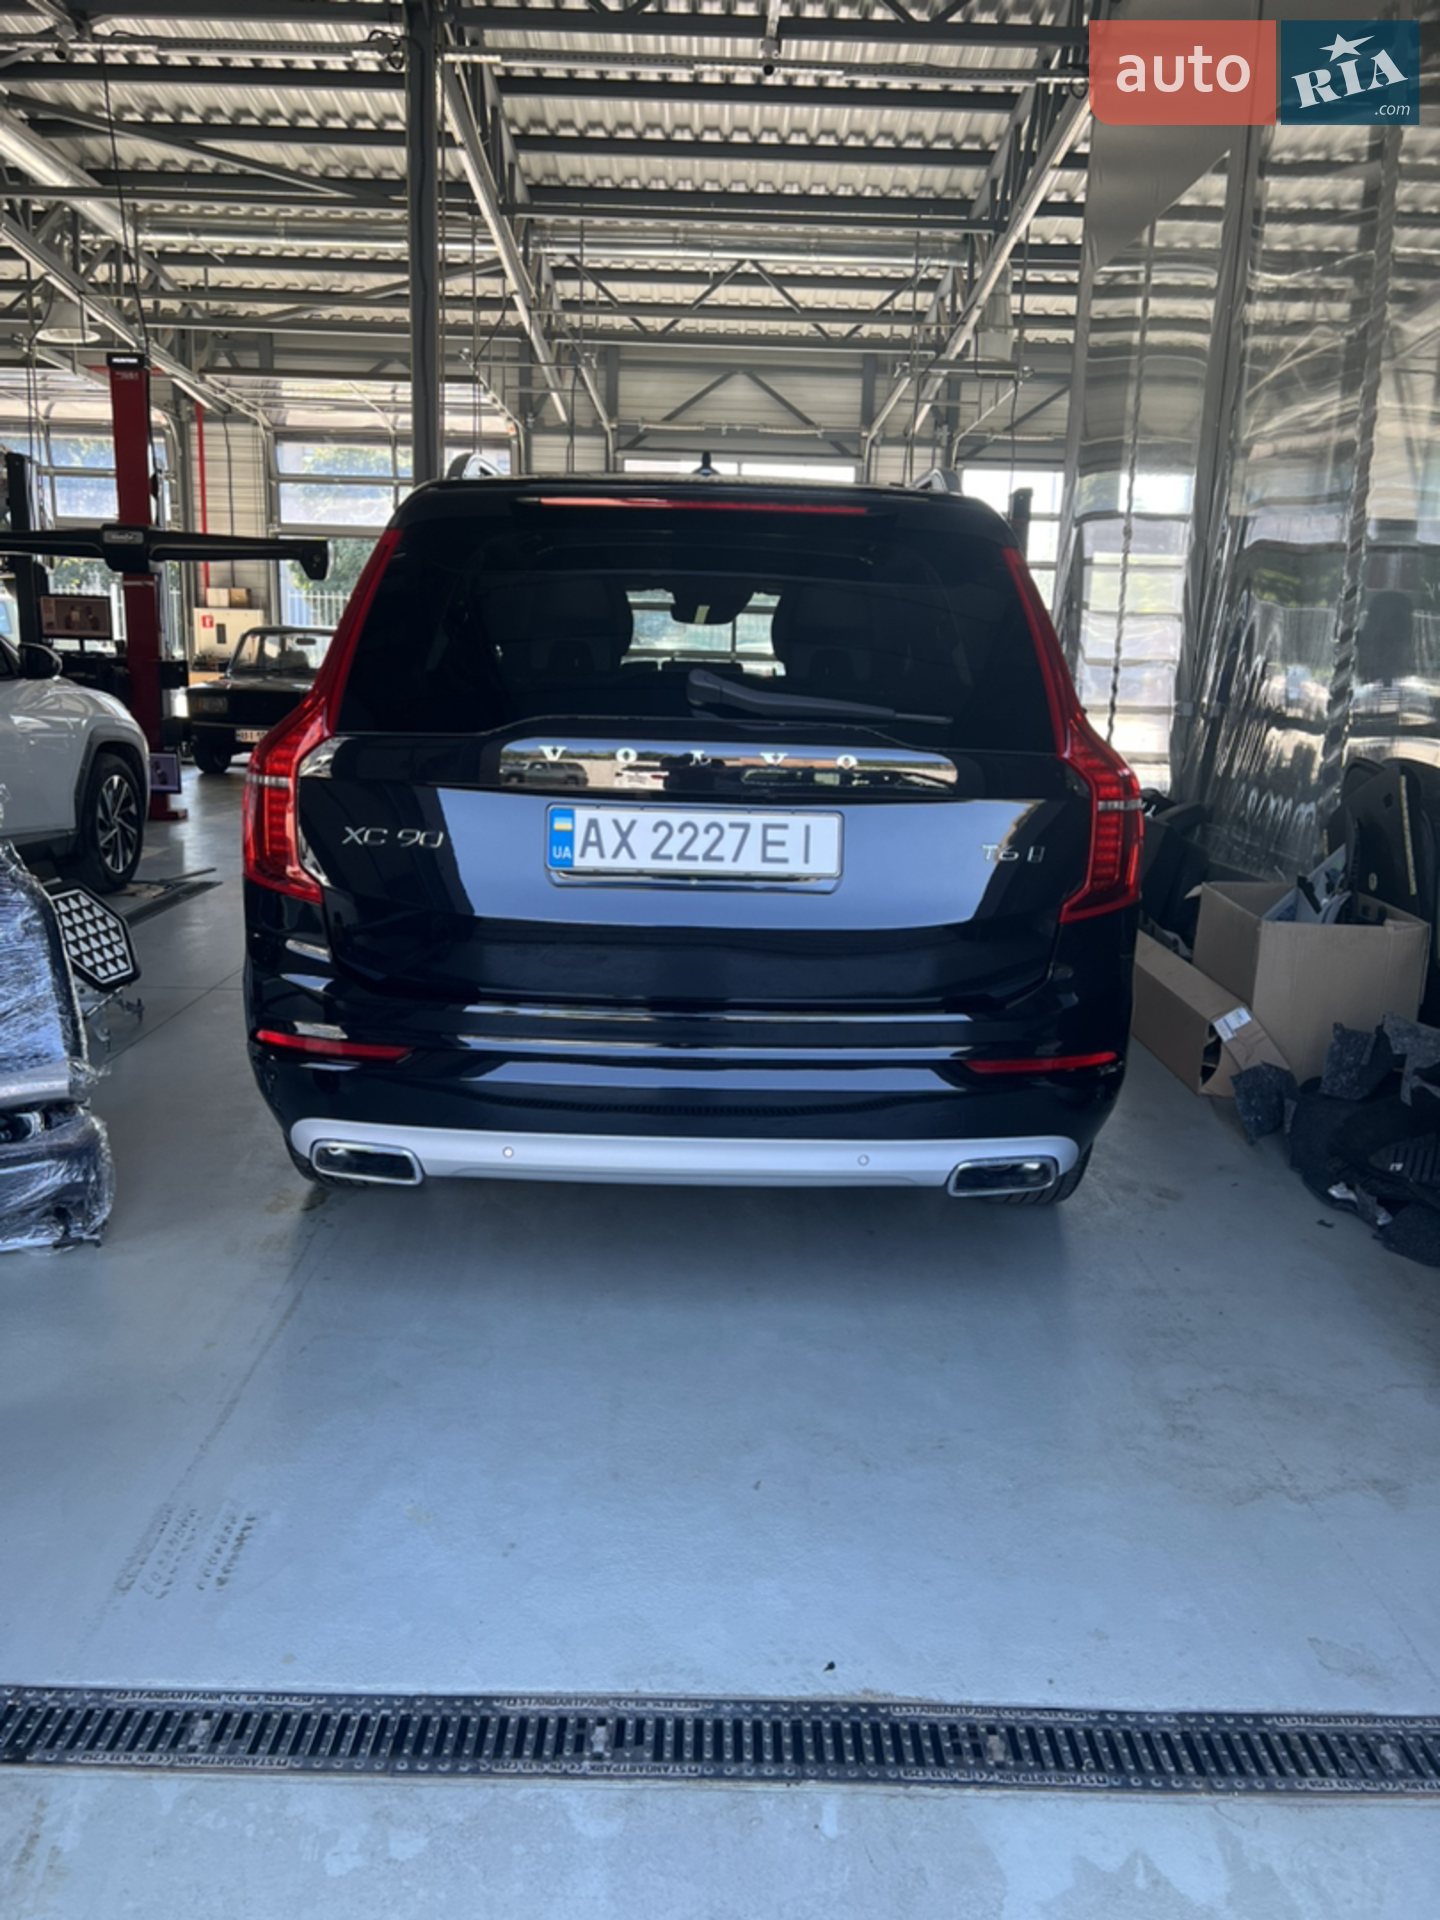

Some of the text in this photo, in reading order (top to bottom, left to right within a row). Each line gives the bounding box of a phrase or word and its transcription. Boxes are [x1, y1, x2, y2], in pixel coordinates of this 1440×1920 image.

[538, 745, 859, 771] VOLVO
[342, 826, 444, 849] XC 90
[579, 818, 637, 860] AX
[650, 820, 752, 863] 2227
[552, 846, 572, 860] UA
